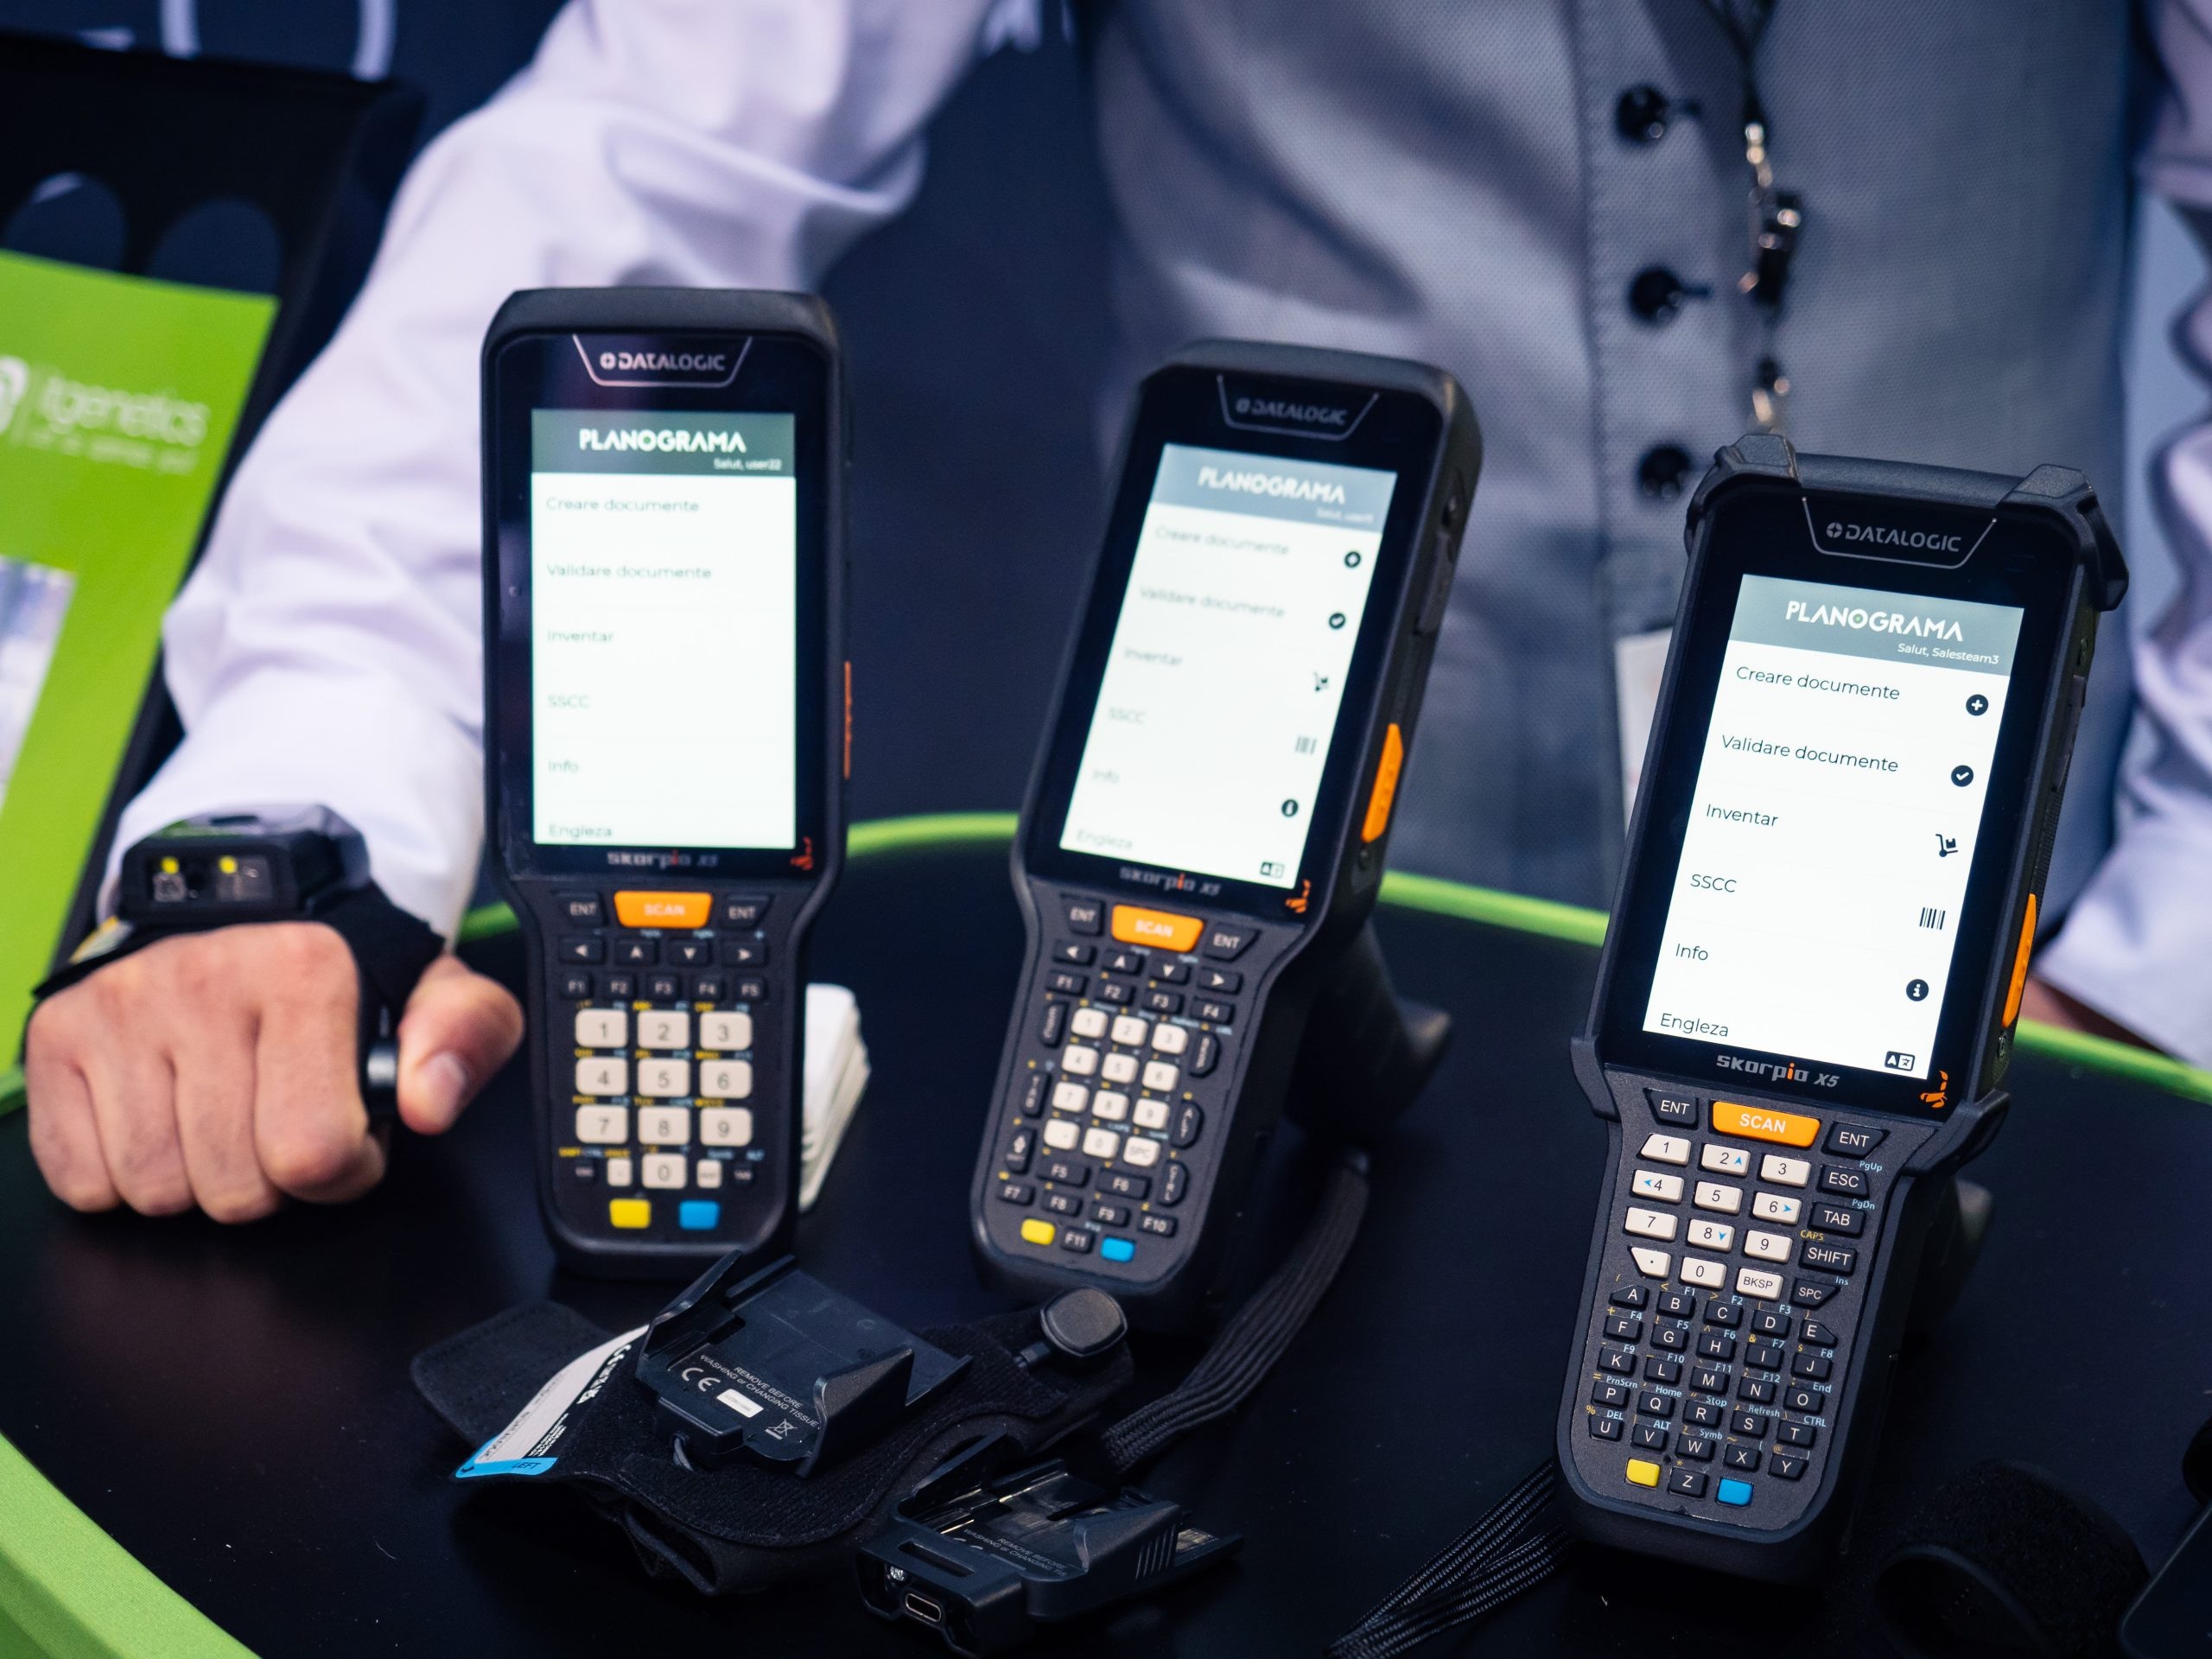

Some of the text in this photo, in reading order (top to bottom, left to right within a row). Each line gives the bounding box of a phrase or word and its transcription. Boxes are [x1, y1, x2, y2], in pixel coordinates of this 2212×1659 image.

[618, 353, 725, 371] DATALOGIC
[1252, 399, 1347, 425] DATALOGIC
[579, 429, 747, 453] PLANOGRAMA
[1198, 467, 1345, 505] PLANOGRAMA
[546, 497, 699, 513] Creare documente
[1154, 525, 1289, 556] Creare documente
[1846, 524, 1962, 553] DATALOGIC
[547, 563, 712, 580] Validare documente
[1140, 586, 1285, 619] Validare documente
[1785, 601, 1963, 642] PLANOGRAMA
[548, 630, 613, 643] Inventar
[1125, 647, 1183, 667] Inventar
[1897, 643, 1999, 665] Salut, Salesteam3
[1736, 666, 1900, 700] Creare documente
[548, 696, 590, 709] SSCC
[1108, 707, 1147, 724] SSCC
[1721, 734, 1899, 772] Validare documente
[549, 760, 579, 773] Info
[1706, 804, 1779, 828] Inventar
[549, 824, 613, 840] Engleza
[1077, 829, 1133, 850] Engleza
[1690, 873, 1737, 893] SSCC
[570, 903, 596, 915] ENT
[644, 903, 685, 916] SCAN
[728, 906, 755, 919] ENT
[1070, 908, 1096, 923] ENT
[1135, 919, 1173, 938] SCAN
[1213, 933, 1240, 949] ENT
[1675, 943, 1709, 962] Info
[569, 981, 585, 993] F1
[611, 981, 628, 994] F2
[655, 981, 672, 995] F3
[1057, 975, 1072, 988] F1
[699, 983, 716, 995] F4
[1104, 985, 1121, 999] F2
[1153, 995, 1169, 1009] F3
[1203, 1004, 1219, 1018] F4
[600, 1022, 607, 1038] 1
[1660, 1013, 1729, 1038] Engleza
[658, 1024, 671, 1041] 2
[717, 1025, 729, 1042] 3
[597, 1071, 610, 1085] 4
[1716, 1055, 1840, 1088] skorpio X5
[658, 1071, 670, 1089] 5
[717, 1073, 729, 1090] 6
[1660, 1100, 1689, 1115] ENT
[599, 1116, 610, 1135] 7
[658, 1119, 671, 1137] 8
[717, 1121, 730, 1138] 9
[1739, 1114, 1786, 1134] SCAN
[1840, 1132, 1869, 1147] ENT
[1131, 1145, 1151, 1158] SPC
[1663, 1141, 1669, 1154] 1
[1719, 1152, 1729, 1165] 2
[1052, 1165, 1068, 1179] F5
[1778, 1163, 1787, 1175] 3
[1859, 1160, 1882, 1173] PgUp
[1113, 1177, 1129, 1192] F6
[1654, 1179, 1662, 1192] 4
[1828, 1173, 1859, 1188] ESC
[1004, 1185, 1020, 1199] F7
[1712, 1190, 1720, 1202] 5
[1051, 1195, 1068, 1211] F8
[1769, 1201, 1777, 1213] 6
[1852, 1198, 1875, 1211] PgDn
[1098, 1206, 1115, 1222] F9
[1824, 1210, 1850, 1225] TAB
[1143, 1217, 1166, 1233] F10
[1647, 1216, 1656, 1228] 7
[1703, 1227, 1713, 1239] 8
[1800, 1230, 1824, 1241] CAPS
[1065, 1234, 1086, 1247] F11
[1760, 1238, 1769, 1251] 9
[1808, 1247, 1851, 1265] SHIFT
[1695, 1265, 1704, 1278] 0
[1744, 1276, 1773, 1289] BKSP
[1835, 1276, 1849, 1286] Ins
[1627, 1288, 1638, 1300] A
[1684, 1287, 1696, 1297] F1
[1798, 1287, 1821, 1300] SPC
[1670, 1298, 1681, 1310] B
[1732, 1296, 1743, 1306] F2
[1630, 1311, 1642, 1320] F4
[1717, 1307, 1728, 1319] C
[1779, 1304, 1790, 1314] F3
[1618, 1321, 1627, 1332] F
[1677, 1319, 1689, 1330] F5
[1765, 1317, 1776, 1329] D
[1663, 1331, 1675, 1343] G
[1724, 1330, 1736, 1339] F6
[1807, 1325, 1816, 1338] E
[1624, 1344, 1636, 1353] F9
[1710, 1341, 1721, 1352] H
[1772, 1339, 1785, 1349] F7
[1667, 1354, 1685, 1363] F10
[1821, 1349, 1833, 1358] F8
[1611, 1355, 1621, 1367] K
[1806, 1360, 1815, 1372] J
[1658, 1364, 1666, 1376] L
[1714, 1363, 1732, 1373] F11
[1606, 1376, 1637, 1389] PrnScrn
[1703, 1374, 1714, 1387] M
[1763, 1372, 1780, 1382] F12
[700, 1355, 737, 1380] WASHING
[746, 1382, 789, 1410] CHANGING
[789, 1408, 820, 1427] TISSUE
[734, 1366, 769, 1389] REMOVE
[768, 1387, 803, 1409] BEFORE
[1656, 1385, 1681, 1398] Home
[1751, 1384, 1761, 1396] N
[1813, 1383, 1832, 1393] End
[1606, 1389, 1616, 1400] P
[1707, 1395, 1727, 1407] Stop
[1797, 1394, 1808, 1406] O
[1650, 1398, 1662, 1410] Q
[1606, 1410, 1623, 1421] DEL
[1696, 1408, 1707, 1420] R
[1748, 1405, 1780, 1417] Refresh
[1600, 1421, 1611, 1433] U
[1653, 1421, 1671, 1430] ALT
[1744, 1417, 1753, 1430] S
[1803, 1415, 1827, 1427] CTRL
[1645, 1431, 1655, 1442] V
[1700, 1428, 1723, 1440] Symb
[1790, 1427, 1800, 1440] T
[1688, 1440, 1702, 1453] W
[1736, 1452, 1748, 1464] X
[1782, 1461, 1792, 1472] Y
[1682, 1476, 1693, 1488] Z
[963, 1529, 1052, 1573] WASHING CHANGING
[997, 1538, 1067, 1569] REMOVE BEFORE
